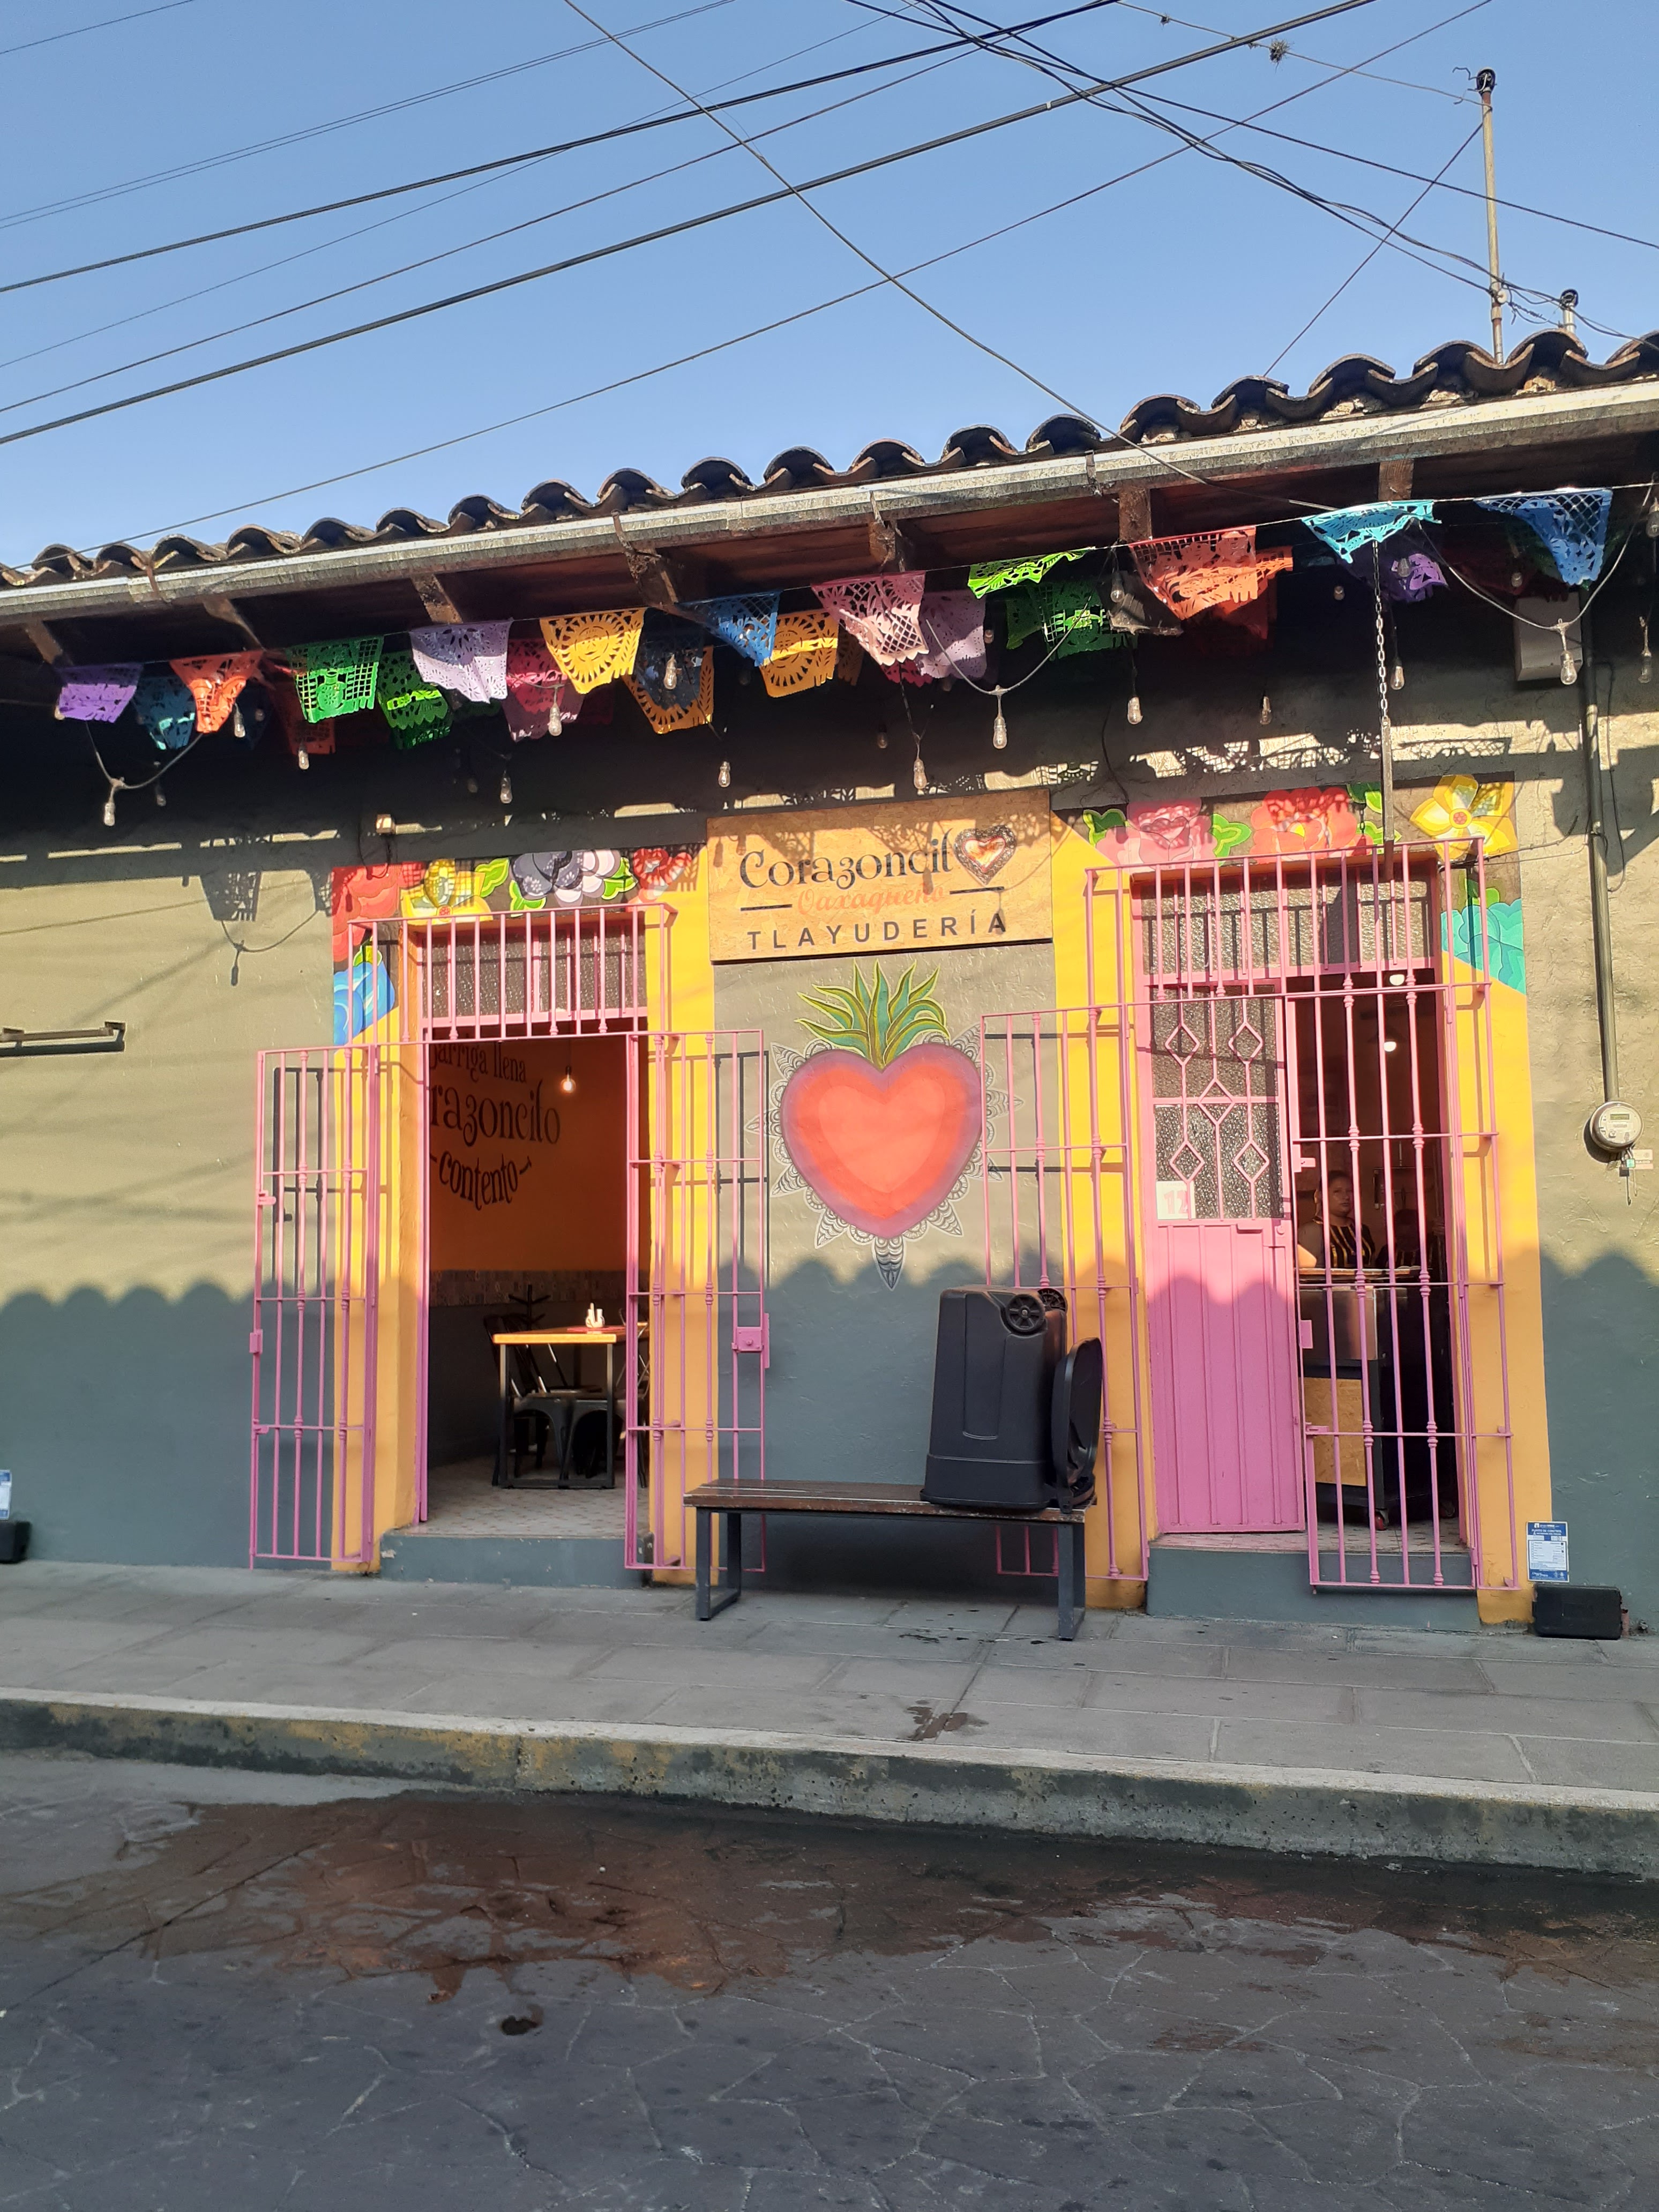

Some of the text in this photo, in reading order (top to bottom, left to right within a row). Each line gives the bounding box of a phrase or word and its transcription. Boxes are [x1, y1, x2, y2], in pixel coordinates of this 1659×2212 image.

[747, 909, 1006, 950] TLAYUDERÍA
[494, 1041, 527, 1083] llena
[439, 1150, 519, 1211] contento
